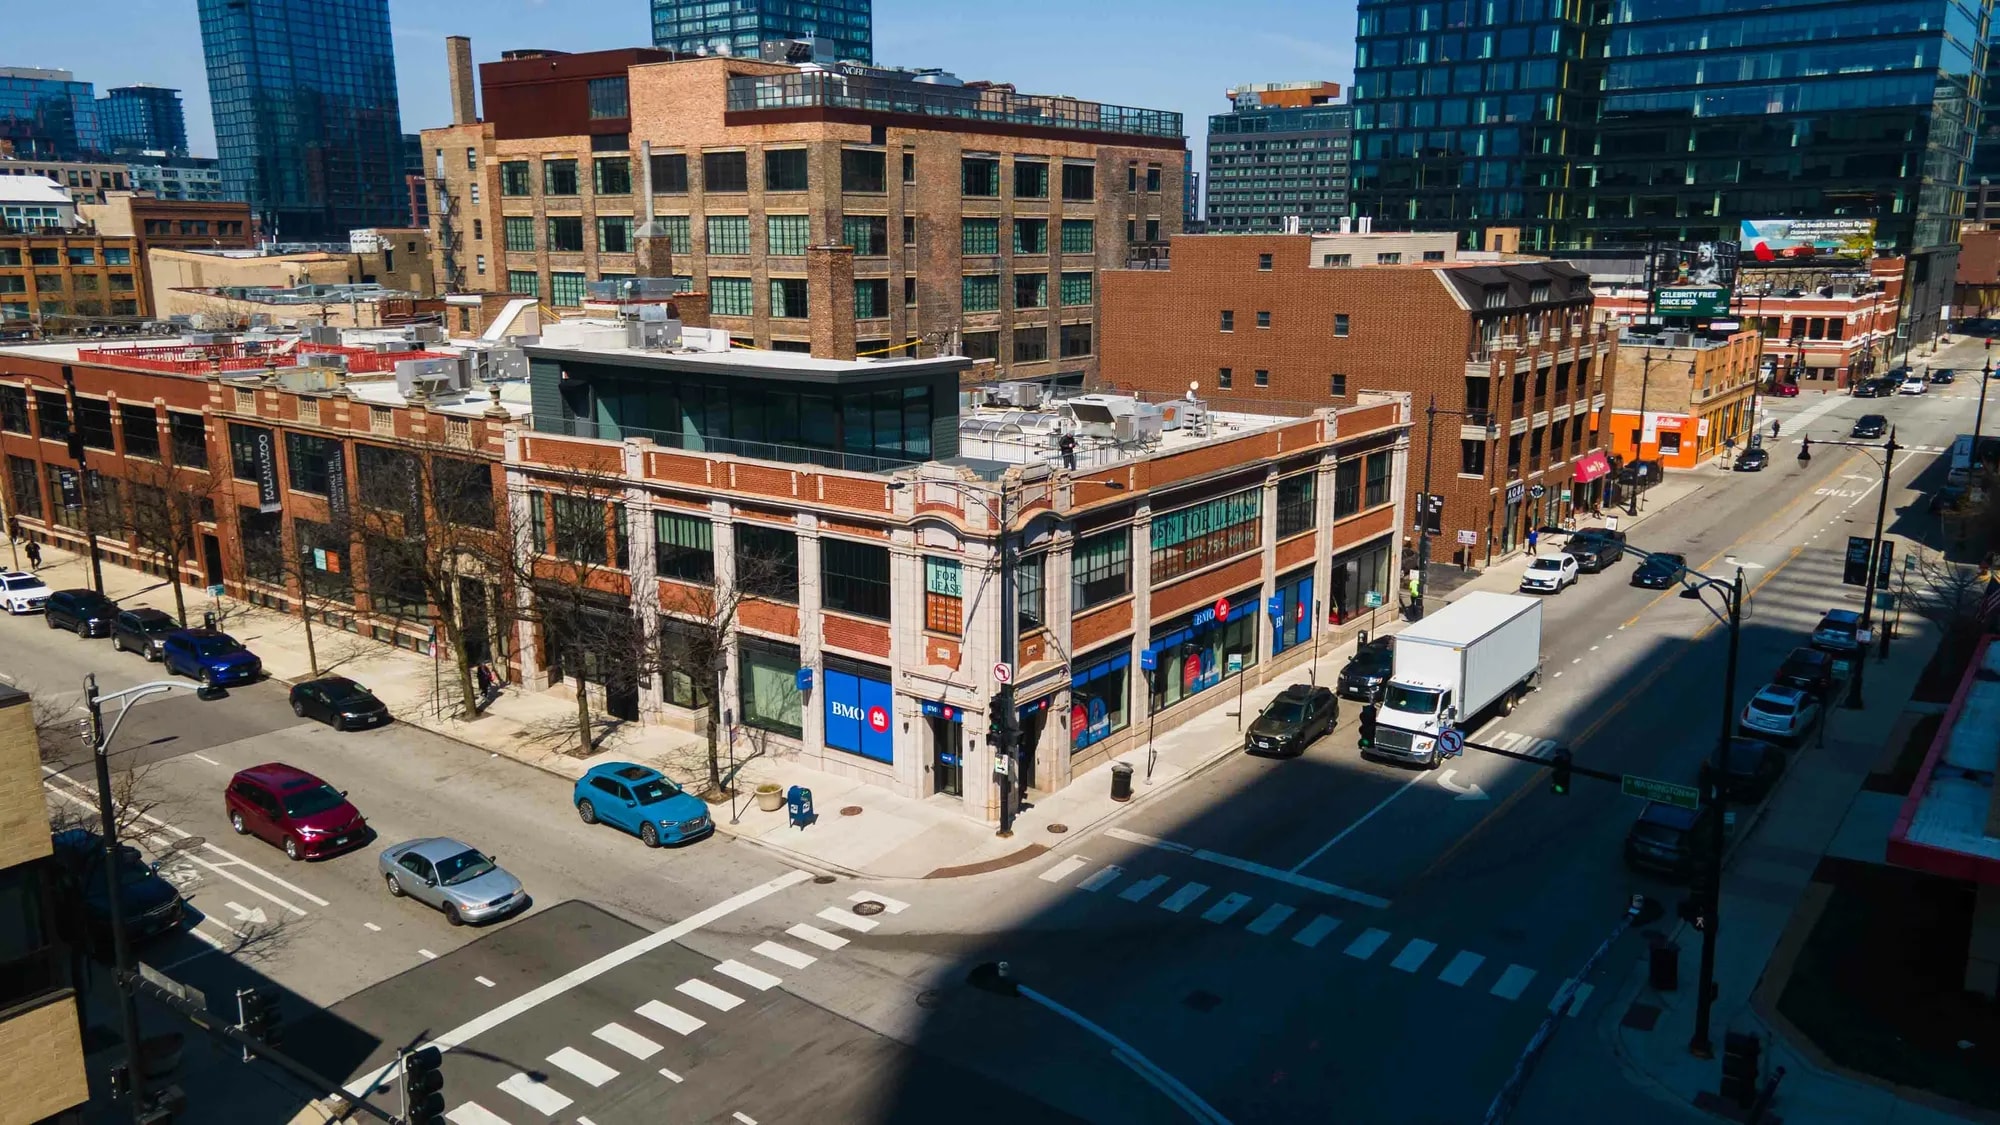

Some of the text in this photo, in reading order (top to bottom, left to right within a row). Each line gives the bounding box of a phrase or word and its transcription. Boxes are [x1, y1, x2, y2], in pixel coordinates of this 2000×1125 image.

[1791, 221, 1806, 229] Sure
[1807, 221, 1826, 229] beats
[1854, 221, 1872, 230] Ryan
[258, 434, 275, 501] KALAMAZOO
[1814, 488, 1863, 497] ONLY
[1181, 509, 1210, 539] FOR
[1215, 497, 1258, 528] LEASE
[936, 570, 957, 582] FOR
[931, 580, 962, 595] LEASE
[1193, 608, 1215, 626] BMO
[831, 701, 865, 721] BMO
